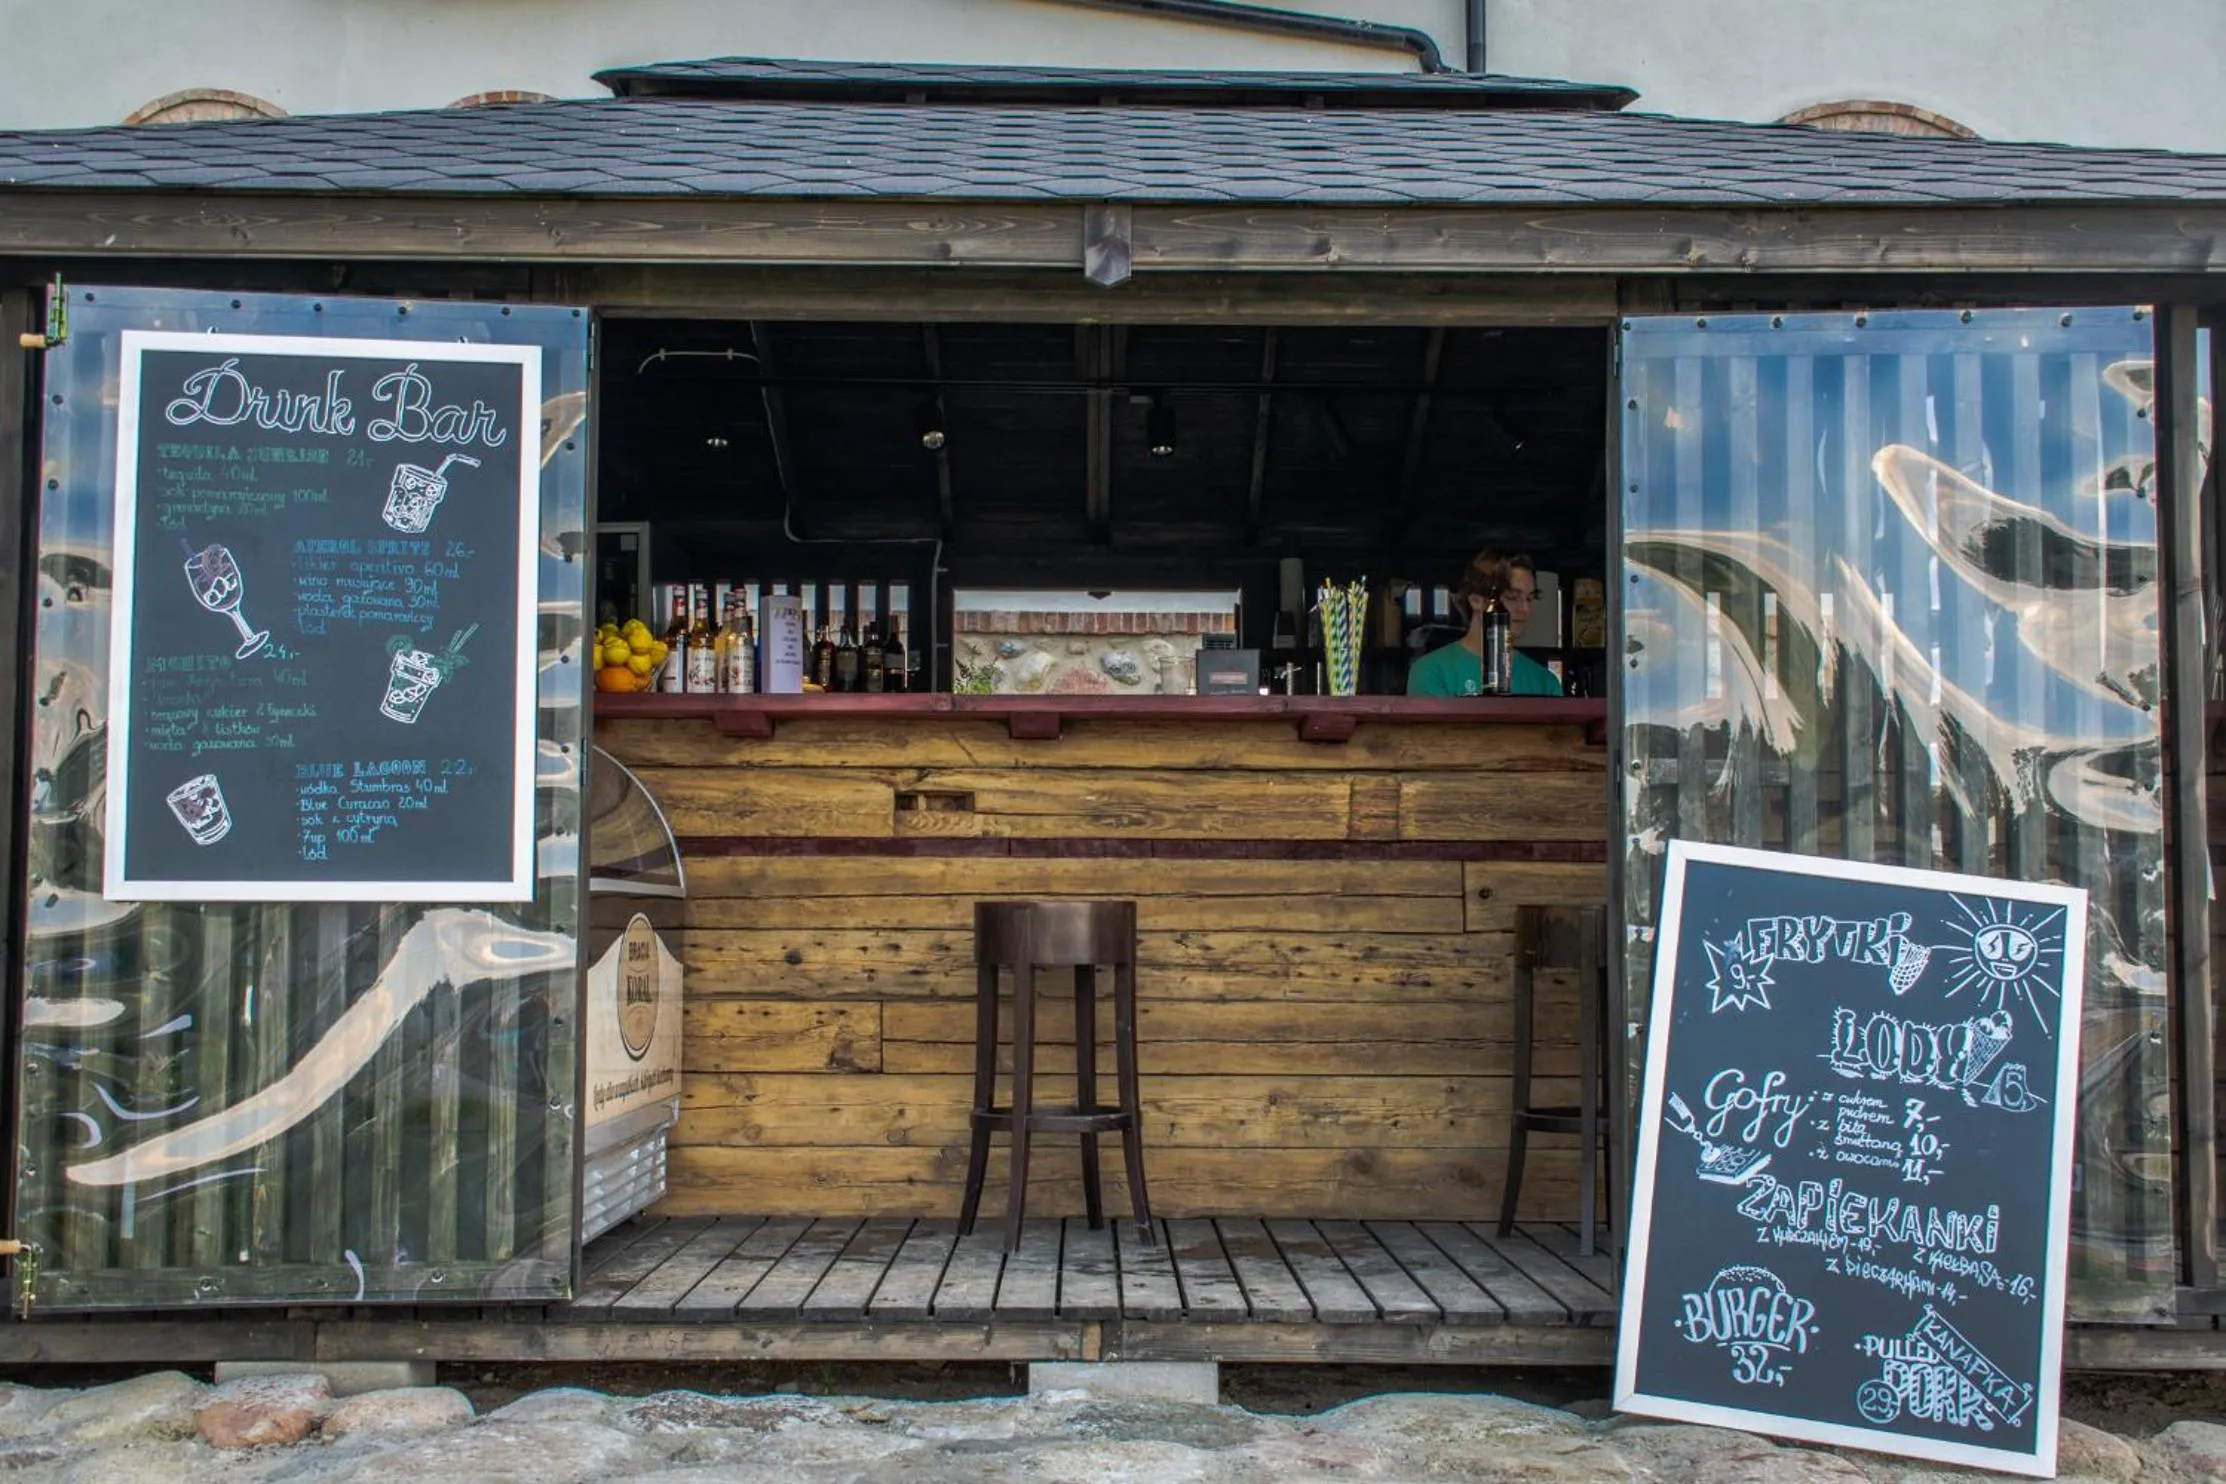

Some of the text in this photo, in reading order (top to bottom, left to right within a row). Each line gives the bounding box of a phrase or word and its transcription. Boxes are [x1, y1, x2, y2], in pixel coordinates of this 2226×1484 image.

[165, 357, 508, 448] Drink Bar
[295, 763, 344, 778] BLUE
[352, 759, 427, 776] LAGOON
[1830, 1007, 1973, 1085] LODY
[1681, 1285, 1816, 1354] BURGER
[1863, 1333, 1940, 1364] PULLED
[1883, 1358, 1995, 1431] PORK
[1922, 1319, 2017, 1413] KANAPKA
